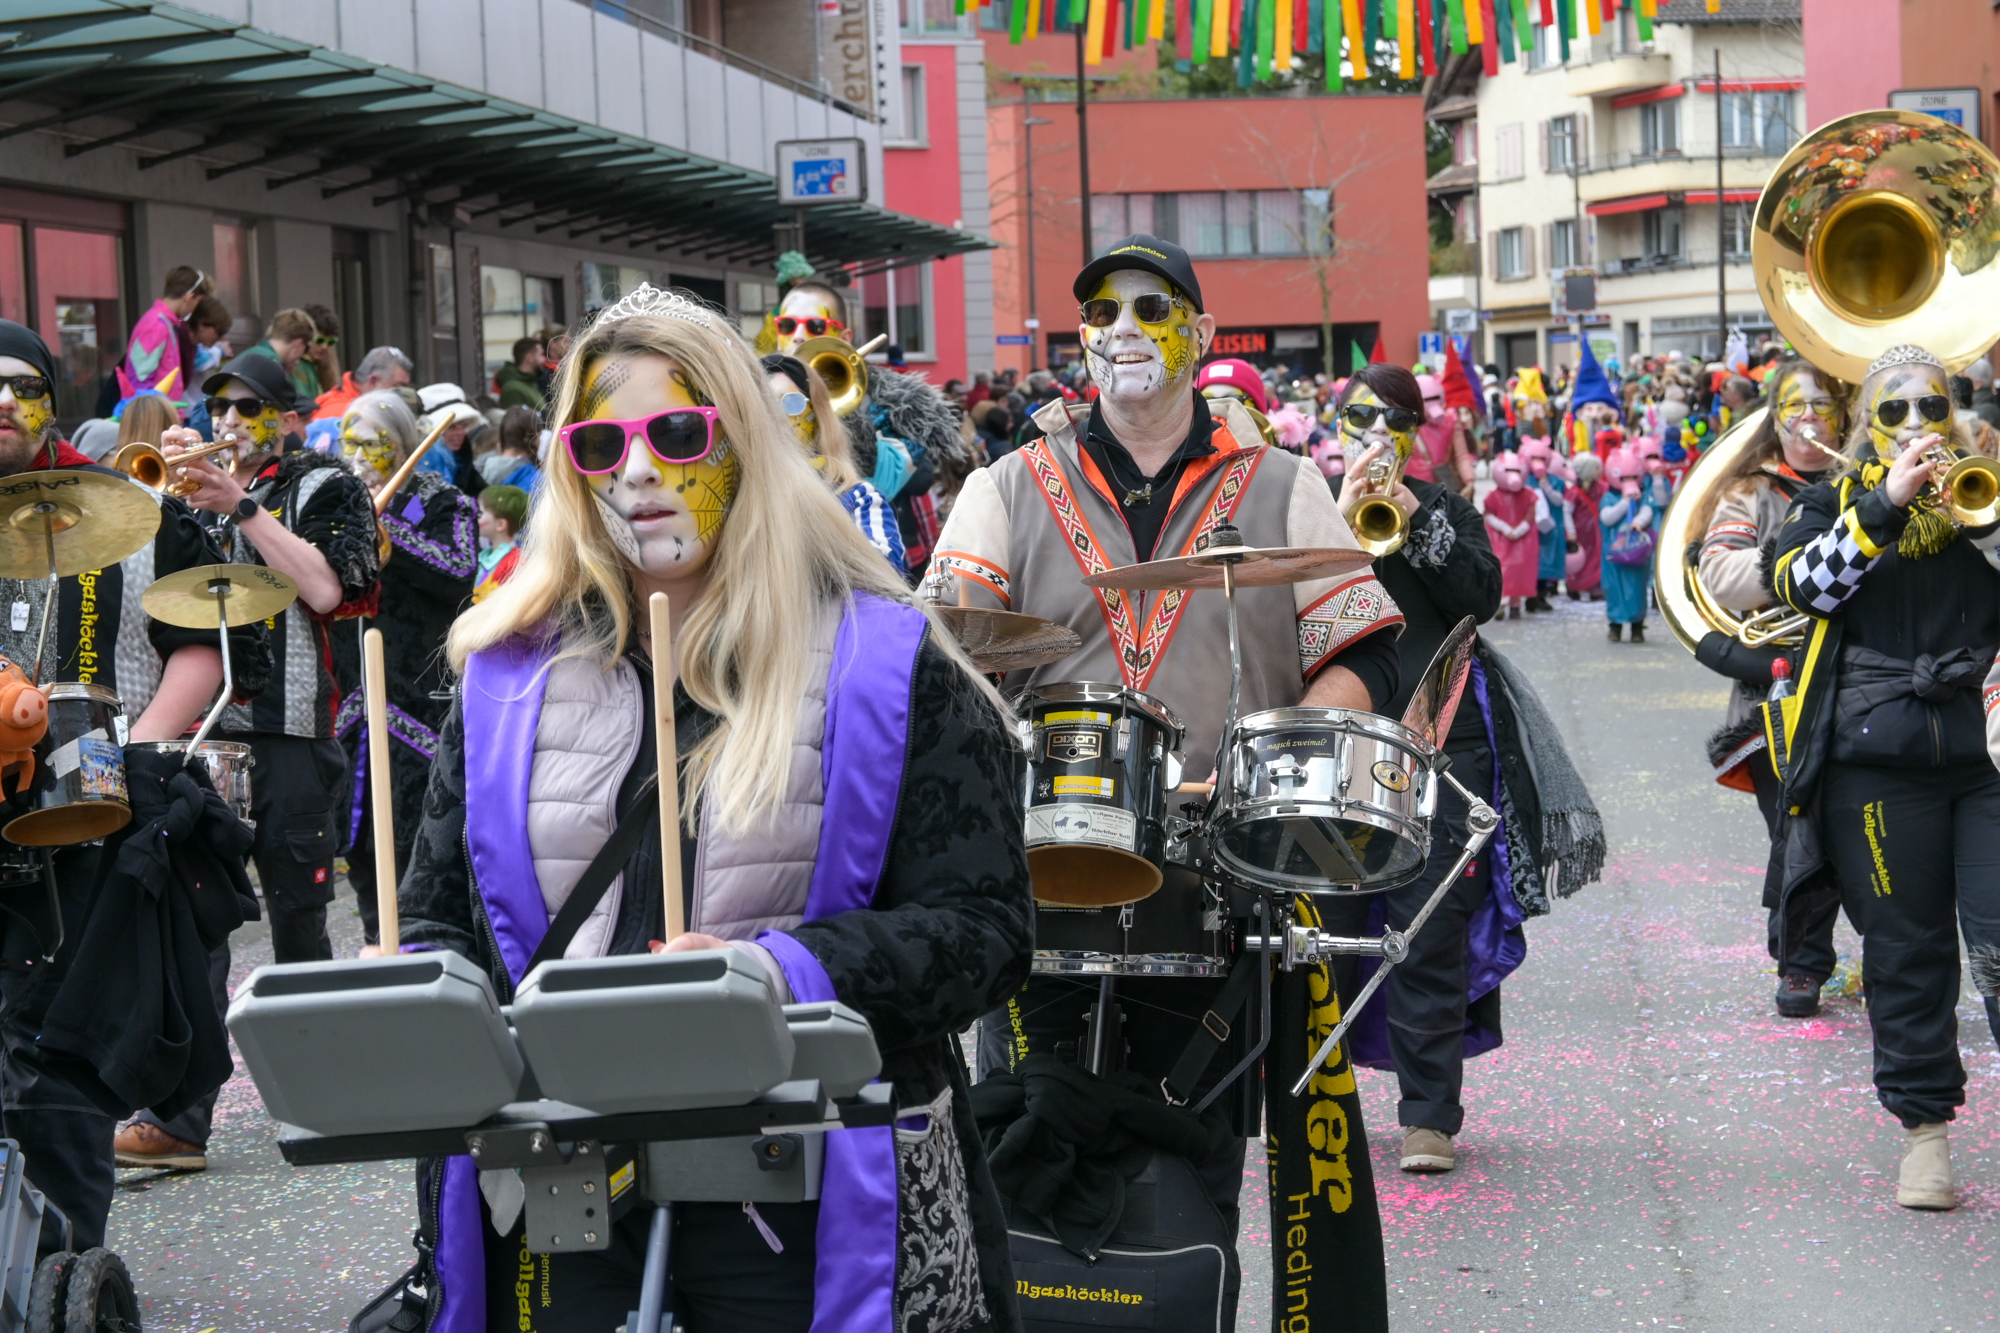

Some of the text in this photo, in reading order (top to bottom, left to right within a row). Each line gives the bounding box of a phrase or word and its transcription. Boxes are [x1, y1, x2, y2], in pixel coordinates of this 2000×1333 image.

[834, 0, 866, 103] ercht
[1920, 96, 1948, 106] ZONE
[1212, 333, 1267, 354] EISEN
[1670, 469, 1684, 495] 7
[1292, 738, 1328, 747] zweimal?
[1863, 802, 1892, 895] Vollgashöckler
[1007, 997, 1029, 1061] shöckl
[515, 1234, 537, 1333] ollgas
[1281, 1192, 1313, 1333] Heding
[1016, 1280, 1143, 1305] llgashöckler
